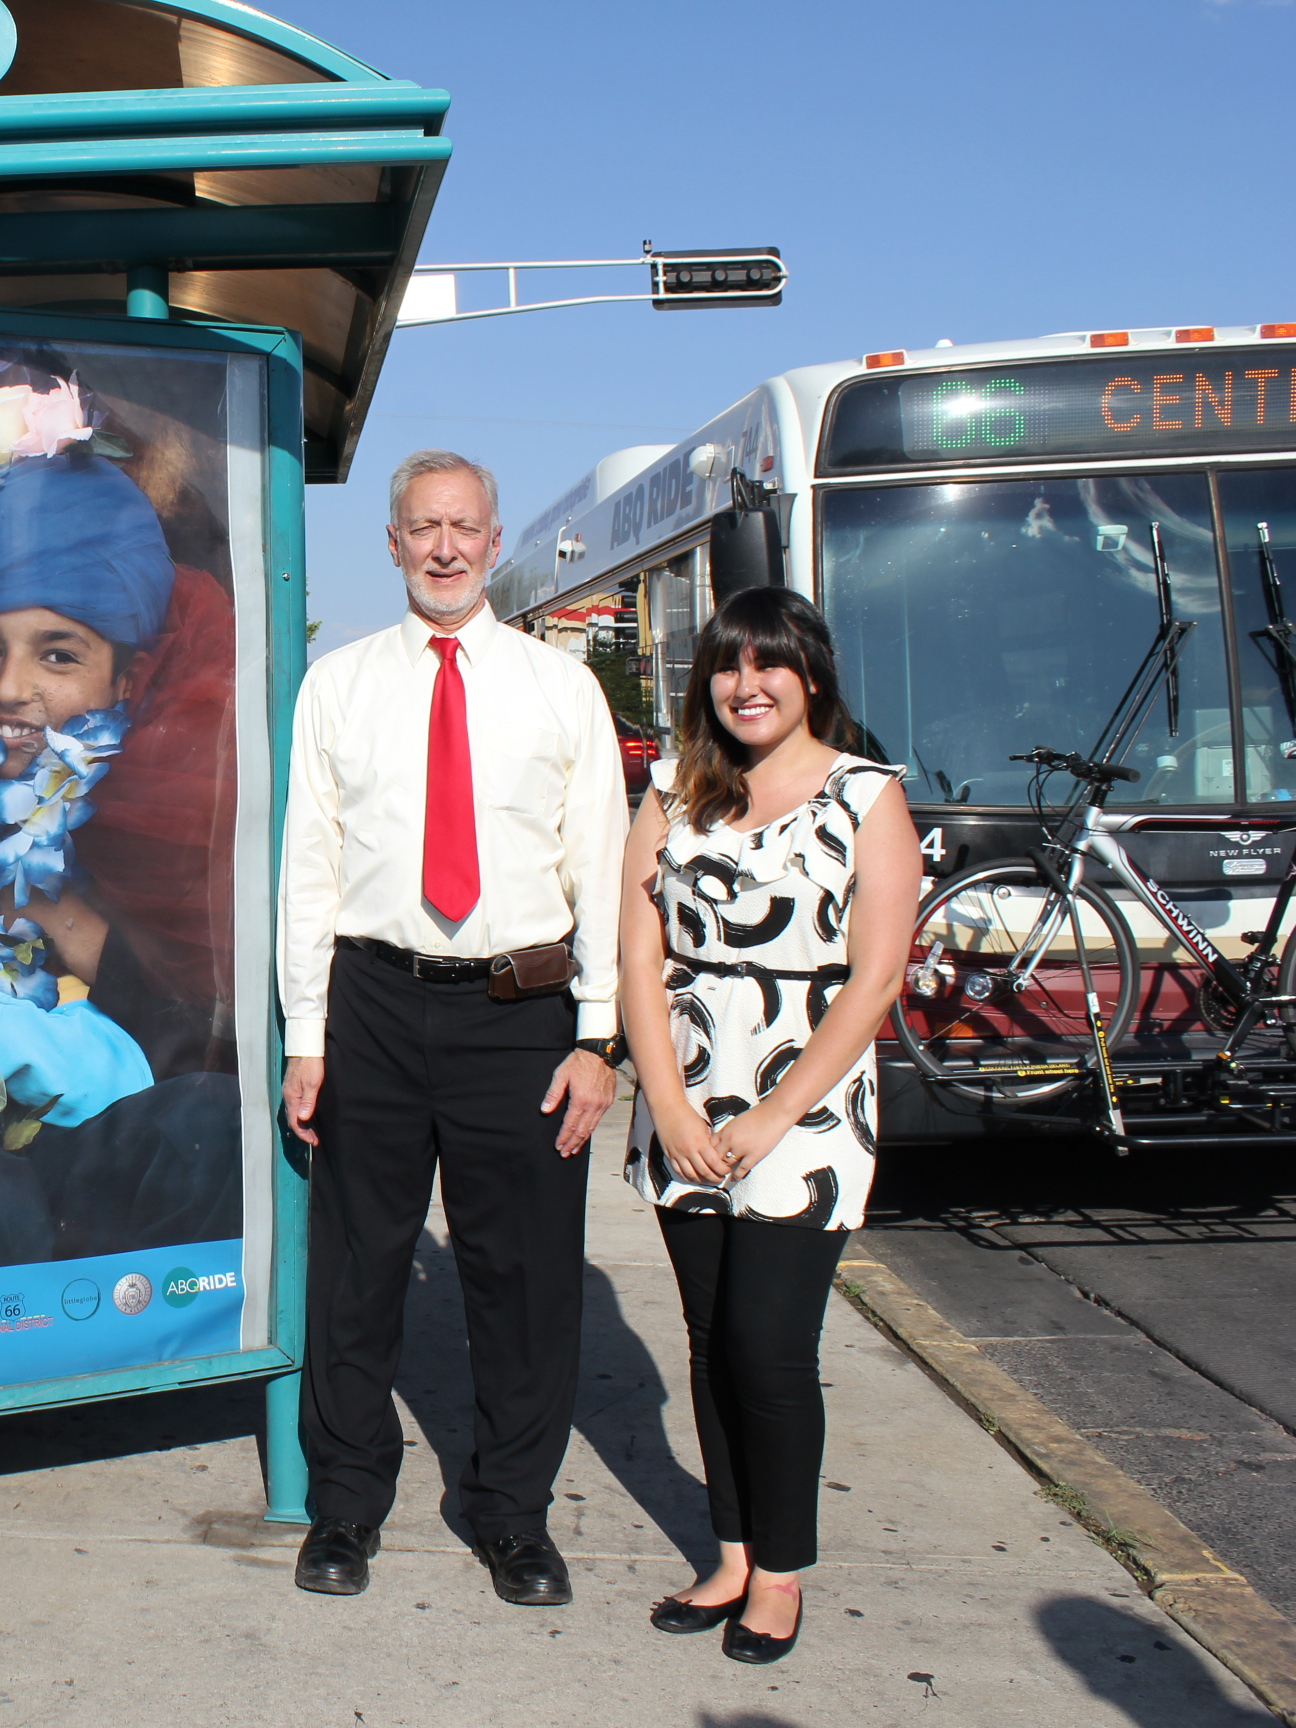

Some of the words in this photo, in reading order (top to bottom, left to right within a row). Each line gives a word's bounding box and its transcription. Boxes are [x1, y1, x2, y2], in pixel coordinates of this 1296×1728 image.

[610, 483, 645, 551] ABQ
[647, 446, 696, 530] RIDE
[1209, 849, 1239, 857] NEW
[1242, 847, 1282, 855] FLYER
[1146, 878, 1219, 963] SCHWINN
[3, 1295, 20, 1303] ROUTE
[63, 1296, 98, 1306] littleglobe
[5, 1304, 21, 1318] 66
[15, 1317, 54, 1329] DISTRICT
